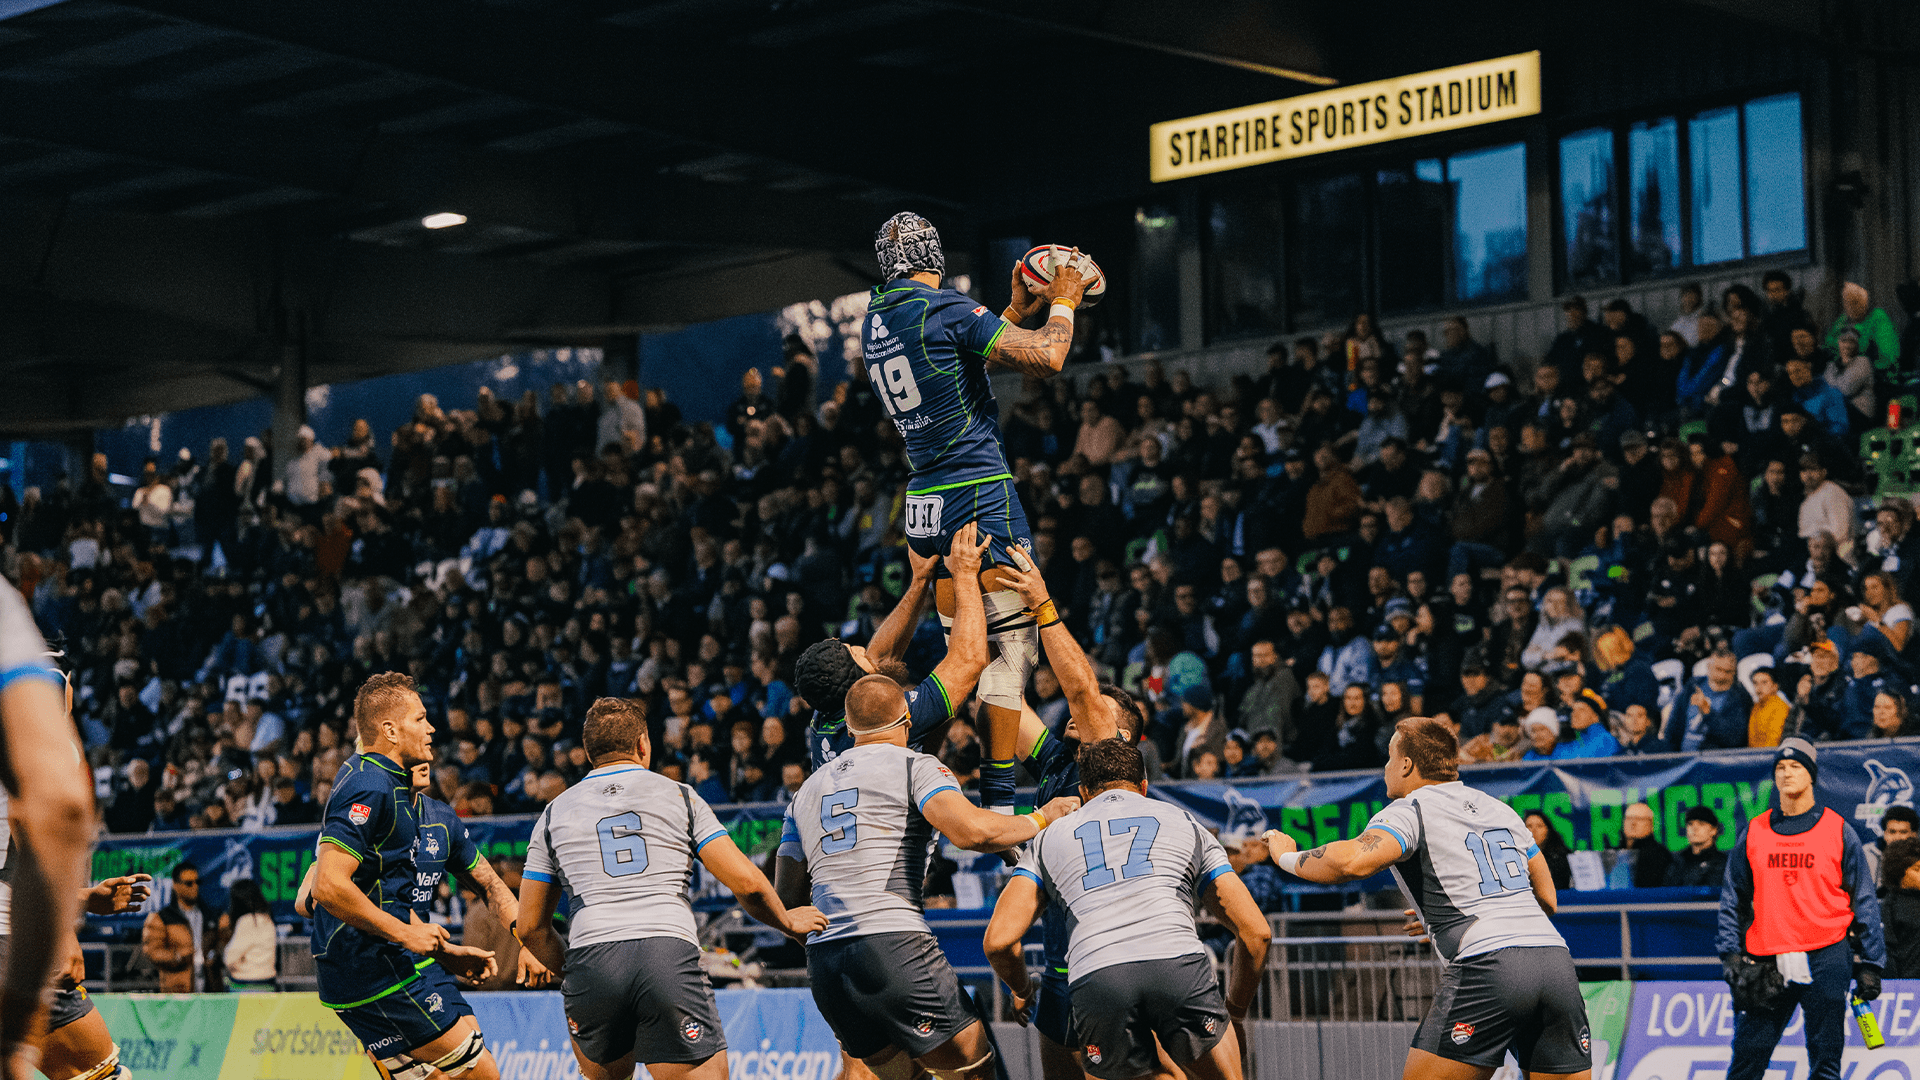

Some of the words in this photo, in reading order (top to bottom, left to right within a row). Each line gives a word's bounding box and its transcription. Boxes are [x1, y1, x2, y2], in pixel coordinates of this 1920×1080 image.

[1169, 114, 1281, 167] STARFIRE
[1291, 95, 1388, 146] SPORTS
[1399, 70, 1517, 125] STADIUM
[869, 355, 922, 416] 19
[352, 805, 369, 816] MLR
[596, 810, 650, 878] 6
[820, 787, 859, 856] 5
[1073, 816, 1161, 890] 17
[1464, 828, 1529, 896] 16
[1768, 853, 1815, 869] MEDIC
[1647, 992, 1734, 1038] LOVE
